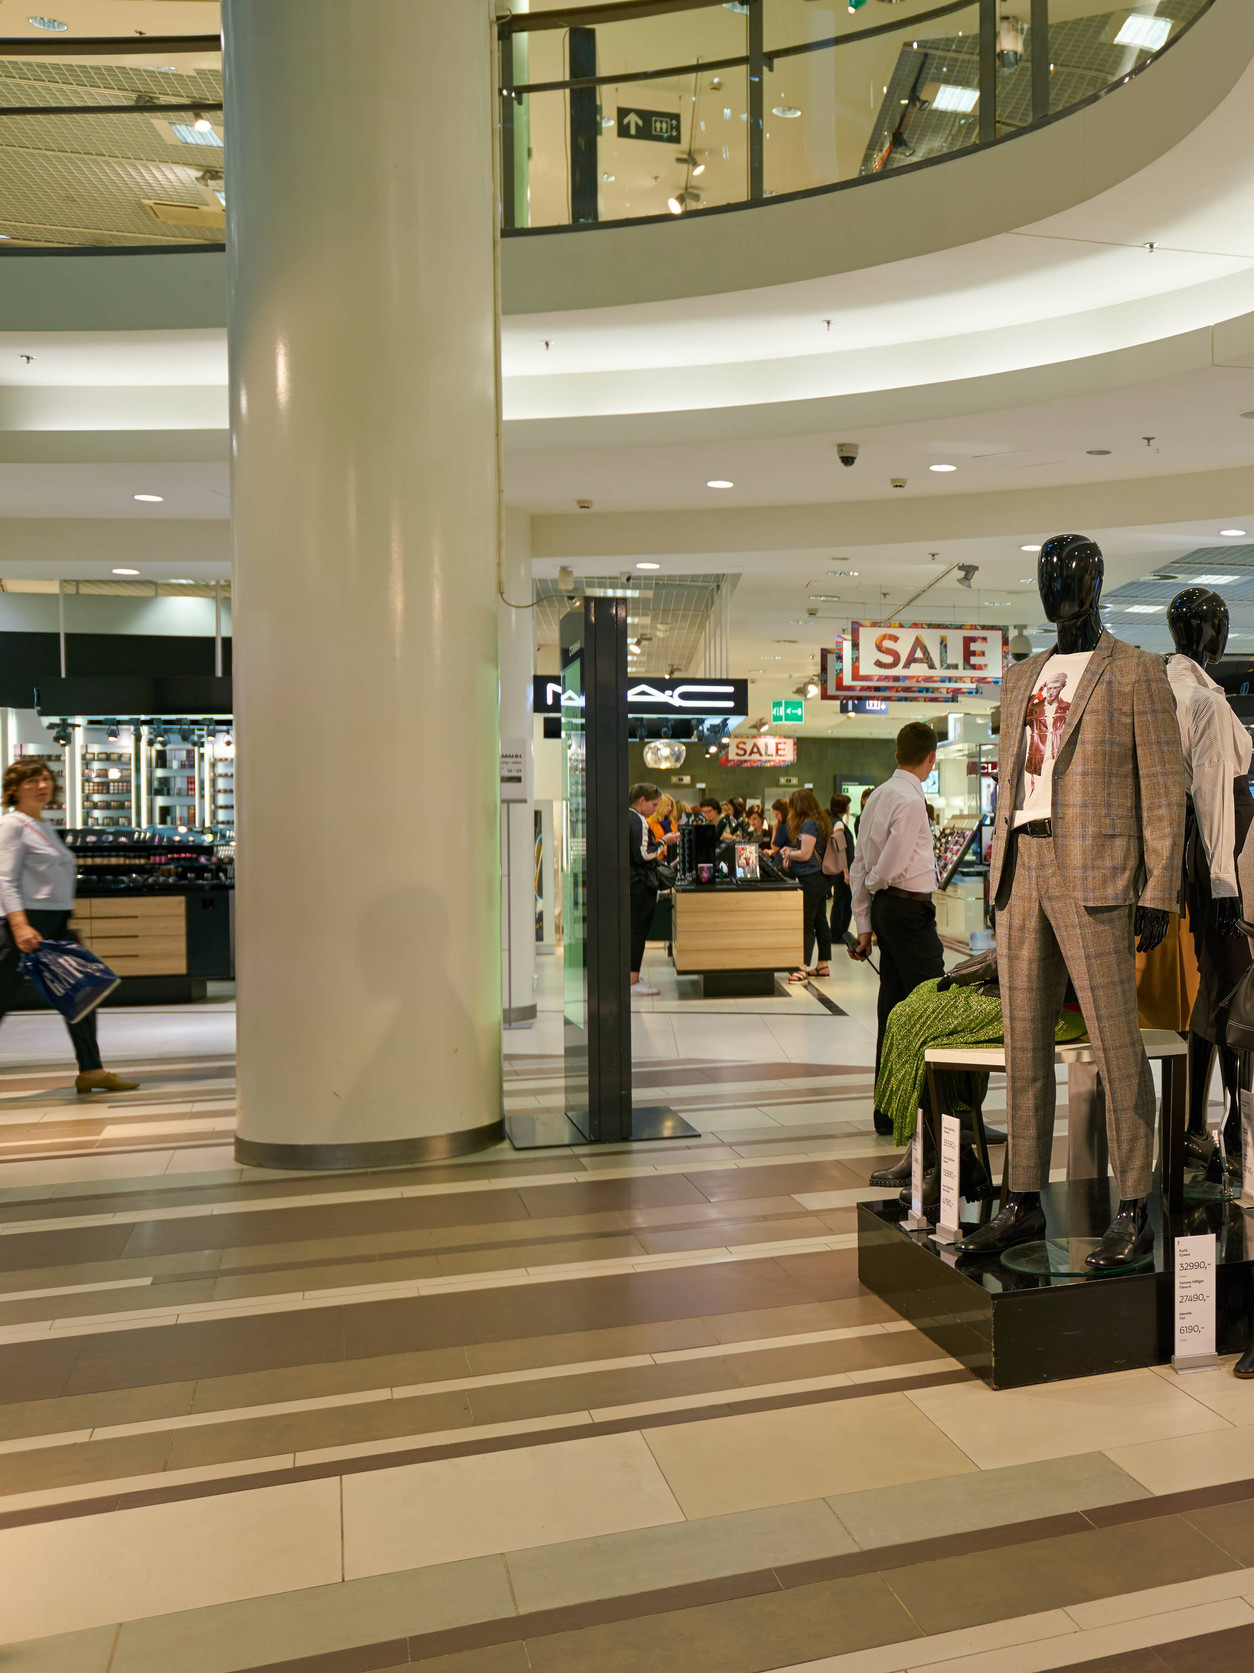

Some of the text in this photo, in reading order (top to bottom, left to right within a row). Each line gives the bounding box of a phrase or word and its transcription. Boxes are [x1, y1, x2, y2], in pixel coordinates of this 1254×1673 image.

[873, 633, 989, 671] SALE
[546, 682, 736, 709] AC
[735, 741, 787, 757] SALE
[980, 763, 999, 773] CL
[1179, 1261, 1211, 1271] 32990,-
[1179, 1293, 1210, 1303] 27490,-
[1179, 1325, 1205, 1335] 6190,-
